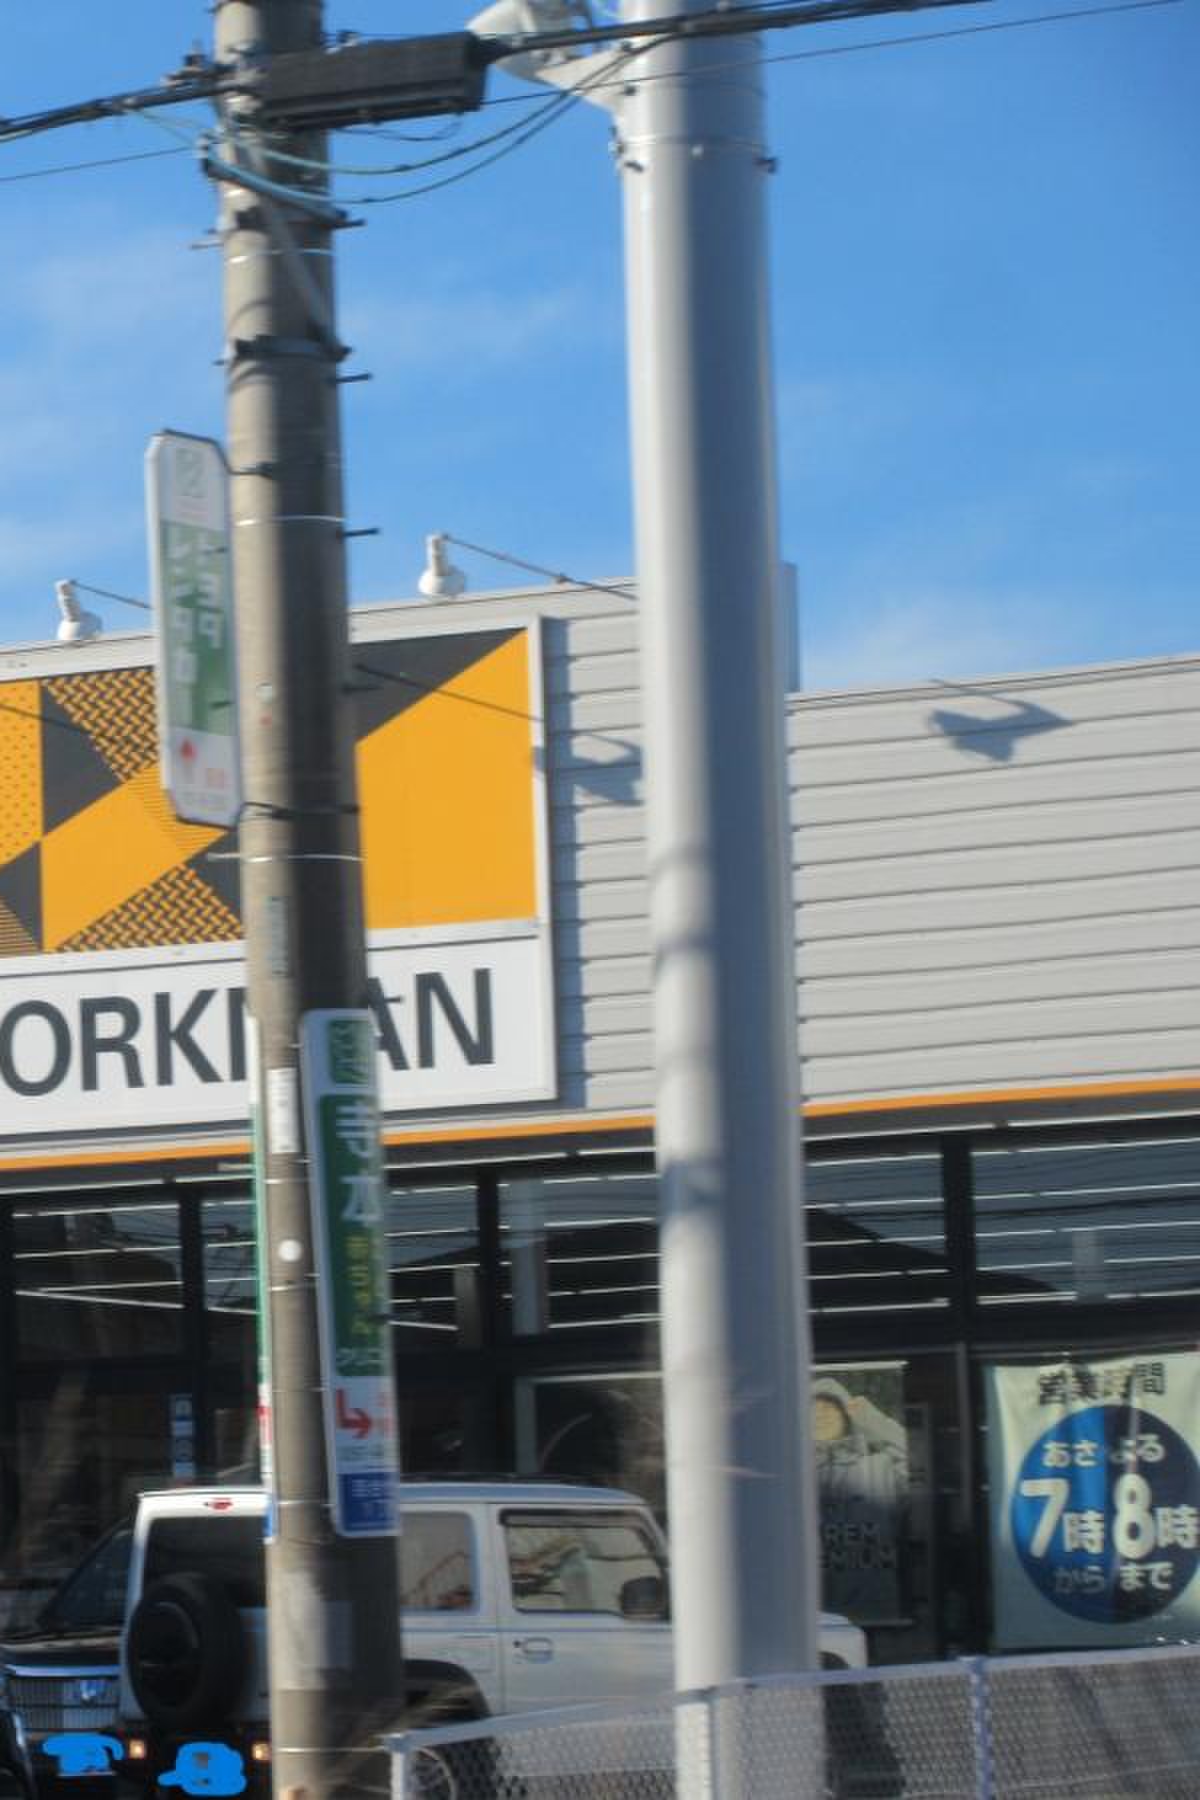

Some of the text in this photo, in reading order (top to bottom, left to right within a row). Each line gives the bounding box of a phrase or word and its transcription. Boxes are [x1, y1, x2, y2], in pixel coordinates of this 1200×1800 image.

[1042, 1440, 1098, 1468] あさ
[1019, 1472, 1199, 1559] 7時 8時
[1054, 1561, 1174, 1594] から まで
